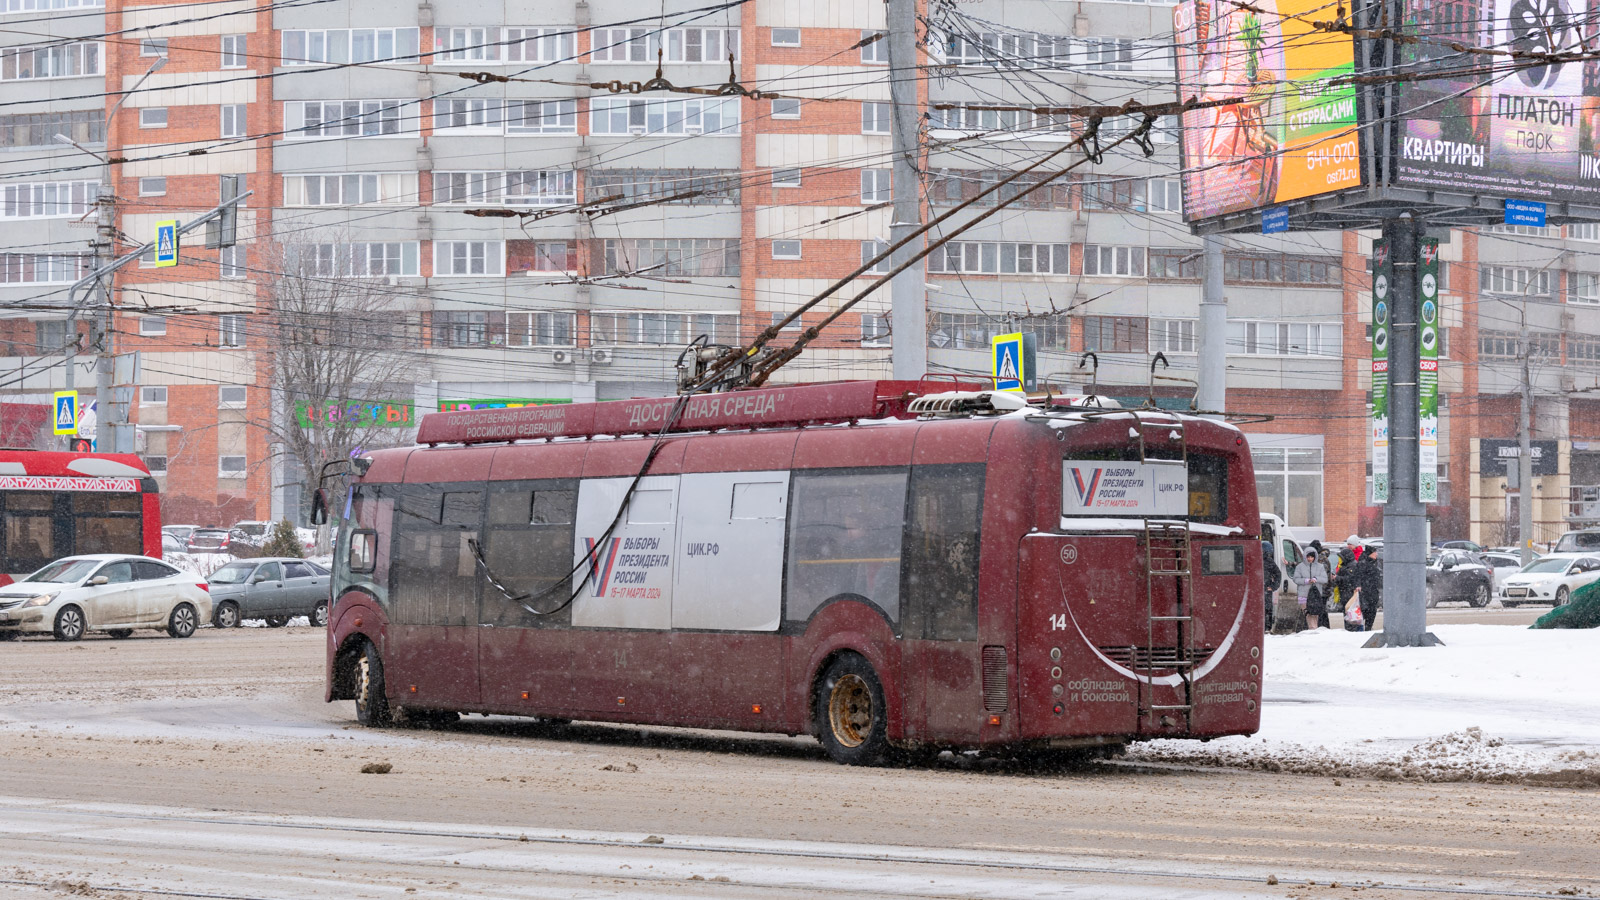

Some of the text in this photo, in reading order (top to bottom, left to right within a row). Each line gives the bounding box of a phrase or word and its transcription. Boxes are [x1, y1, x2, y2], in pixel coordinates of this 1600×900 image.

[1290, 99, 1353, 131] С ТЕРРАСАМИ
[1498, 94, 1574, 127] ПЛАТОН
[1516, 130, 1553, 153] парк
[1307, 141, 1356, 170] 544-070
[1403, 136, 1484, 168] КВАРТИРЫ
[1327, 168, 1356, 184] ost71.ru
[1374, 362, 1387, 371] СБОР
[1420, 361, 1436, 370] СБОР
[448, 412, 517, 426] ГОСУДАРСТВЕННАЯ
[520, 408, 566, 422] ПРОГРАММА
[467, 422, 564, 438] РОССИЙСКОЙ ФЕДЕРАЦИИ
[1105, 468, 1135, 477] ВЫБОРЫ
[1102, 480, 1144, 488] ПРЕЗИДЕНТА
[1158, 483, 1184, 493] ЦИК.РФ
[624, 537, 660, 550] ВЫБОРЫ
[687, 543, 719, 558] ЦИК.РФ
[618, 554, 670, 568] ПРЕЗИДЕНТА
[1063, 549, 1075, 559] 50
[614, 571, 647, 583] РОССИИ
[627, 588, 646, 598] МАРТА
[646, 588, 661, 599] 2024
[1049, 614, 1066, 630] 14
[613, 649, 627, 668] 14
[1069, 678, 1125, 692] соблюдай
[1196, 681, 1248, 694] дистанцию
[1071, 690, 1130, 702] и боковой
[1201, 692, 1244, 704] интервал
